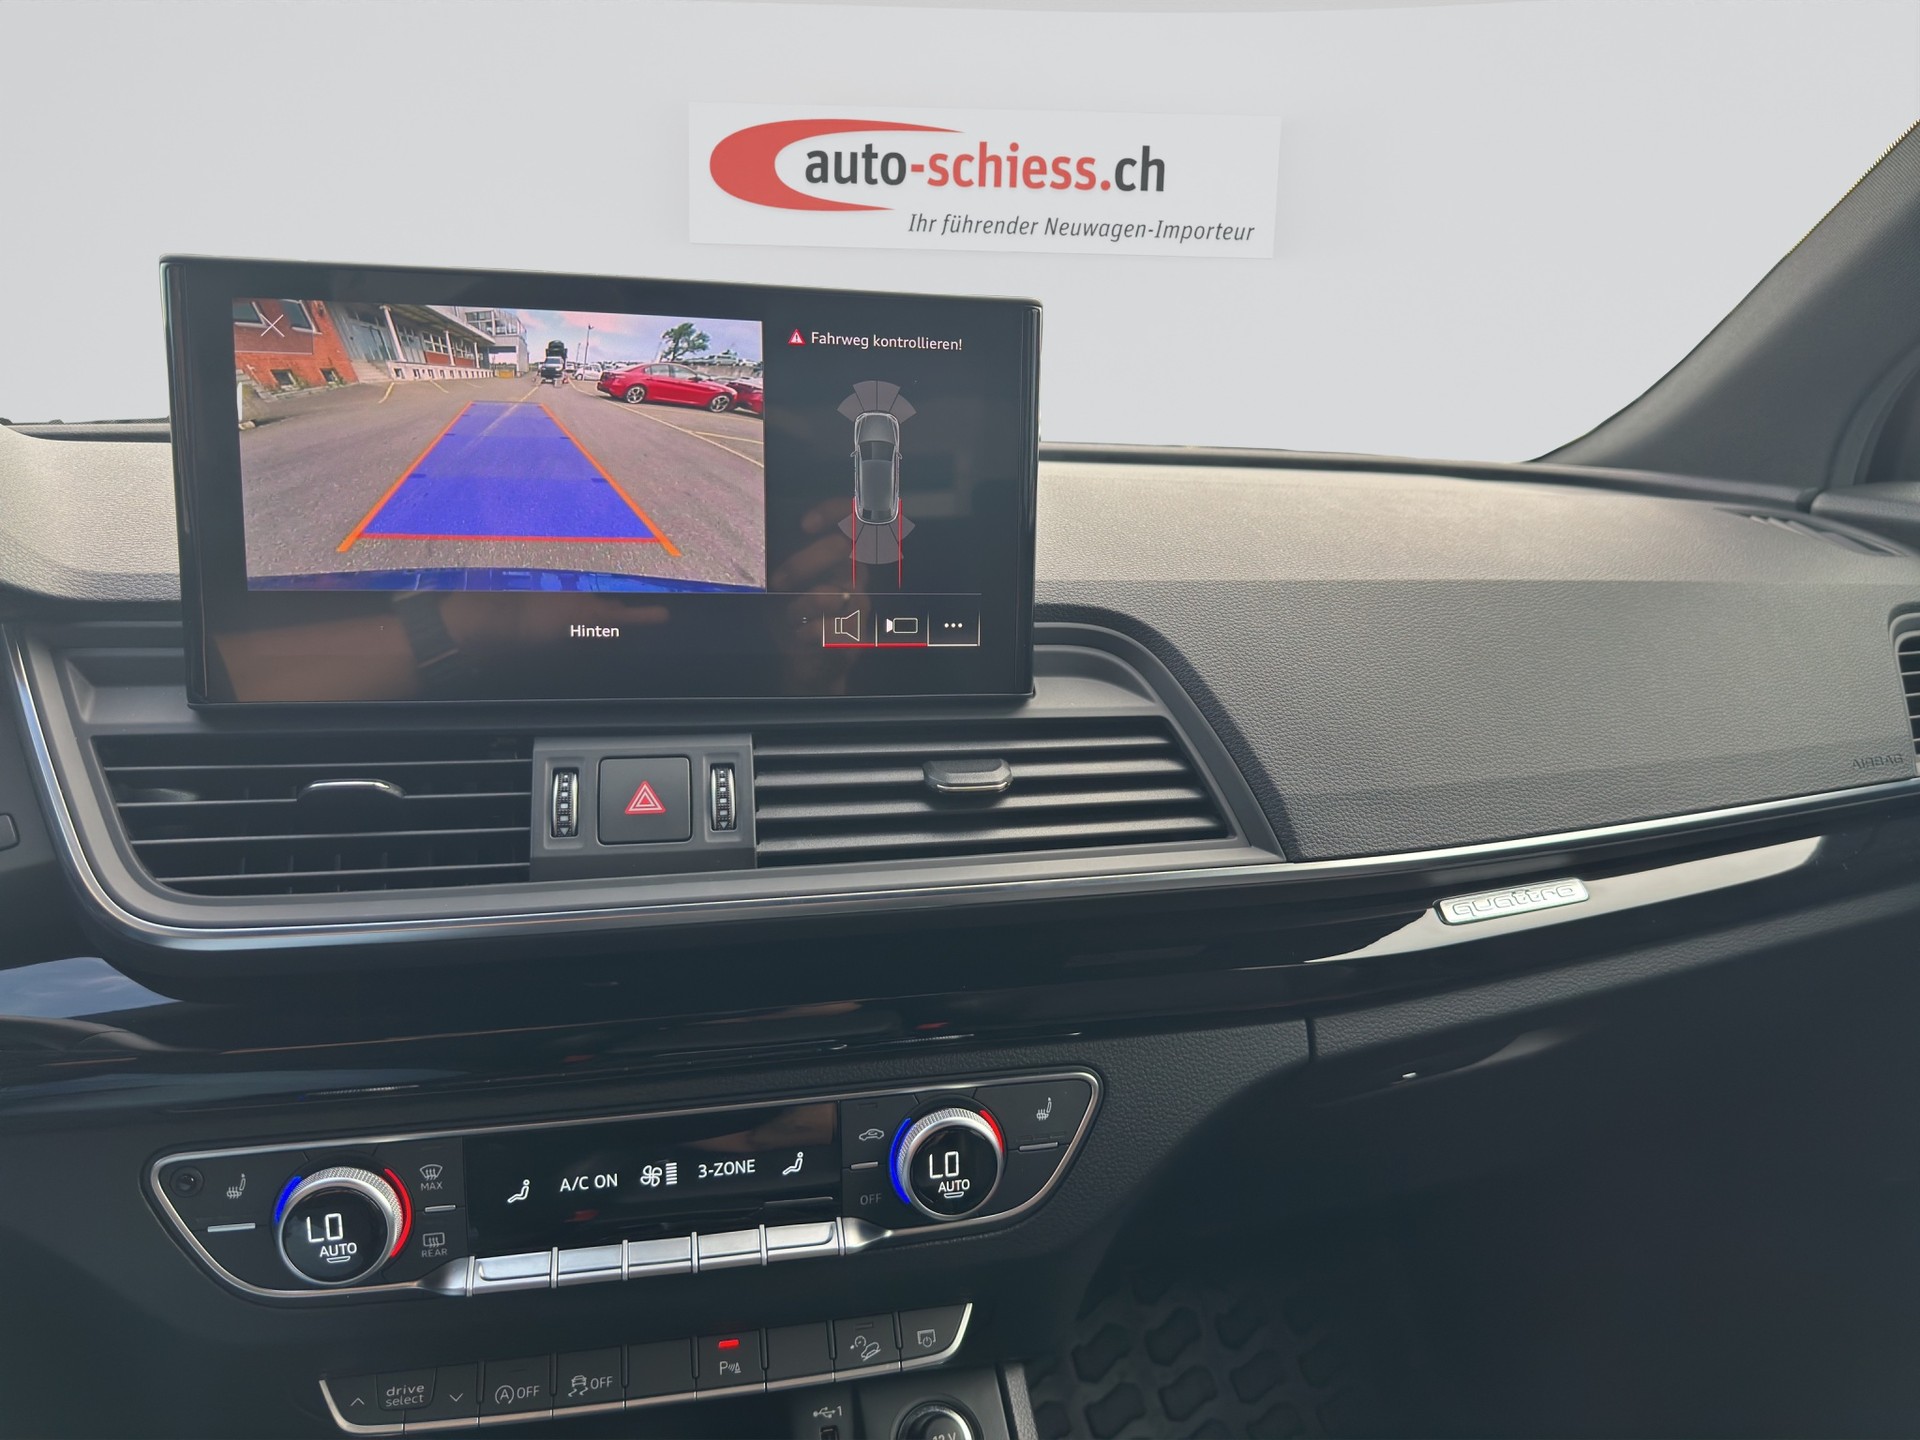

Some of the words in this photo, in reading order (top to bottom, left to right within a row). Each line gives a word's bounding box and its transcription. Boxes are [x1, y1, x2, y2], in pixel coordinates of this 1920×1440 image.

[804, 141, 1166, 193] auto-schiess.ch
[908, 213, 937, 234] Ihr
[940, 213, 1039, 237] führender
[1044, 216, 1256, 244] Neuwagen-Importeur
[810, 330, 869, 349] Fahrweg
[873, 334, 963, 352] kontrollieren!
[570, 624, 620, 638] Hinten
[1852, 753, 1904, 769] AIRBAG
[1452, 885, 1575, 916] quattro
[697, 1158, 756, 1179] 3-ZONE
[420, 1179, 443, 1192] MAX
[559, 1175, 589, 1193] A/C
[593, 1173, 619, 1189] ON
[938, 1178, 971, 1194] AUTO
[860, 1193, 882, 1207] OFF
[319, 1242, 358, 1259] AUTO
[421, 1246, 449, 1258] REAR
[386, 1384, 425, 1397] drive
[590, 1376, 613, 1390] OFF
[516, 1386, 540, 1399] OFF
[385, 1394, 425, 1407] select
[836, 1406, 843, 1416] 1
